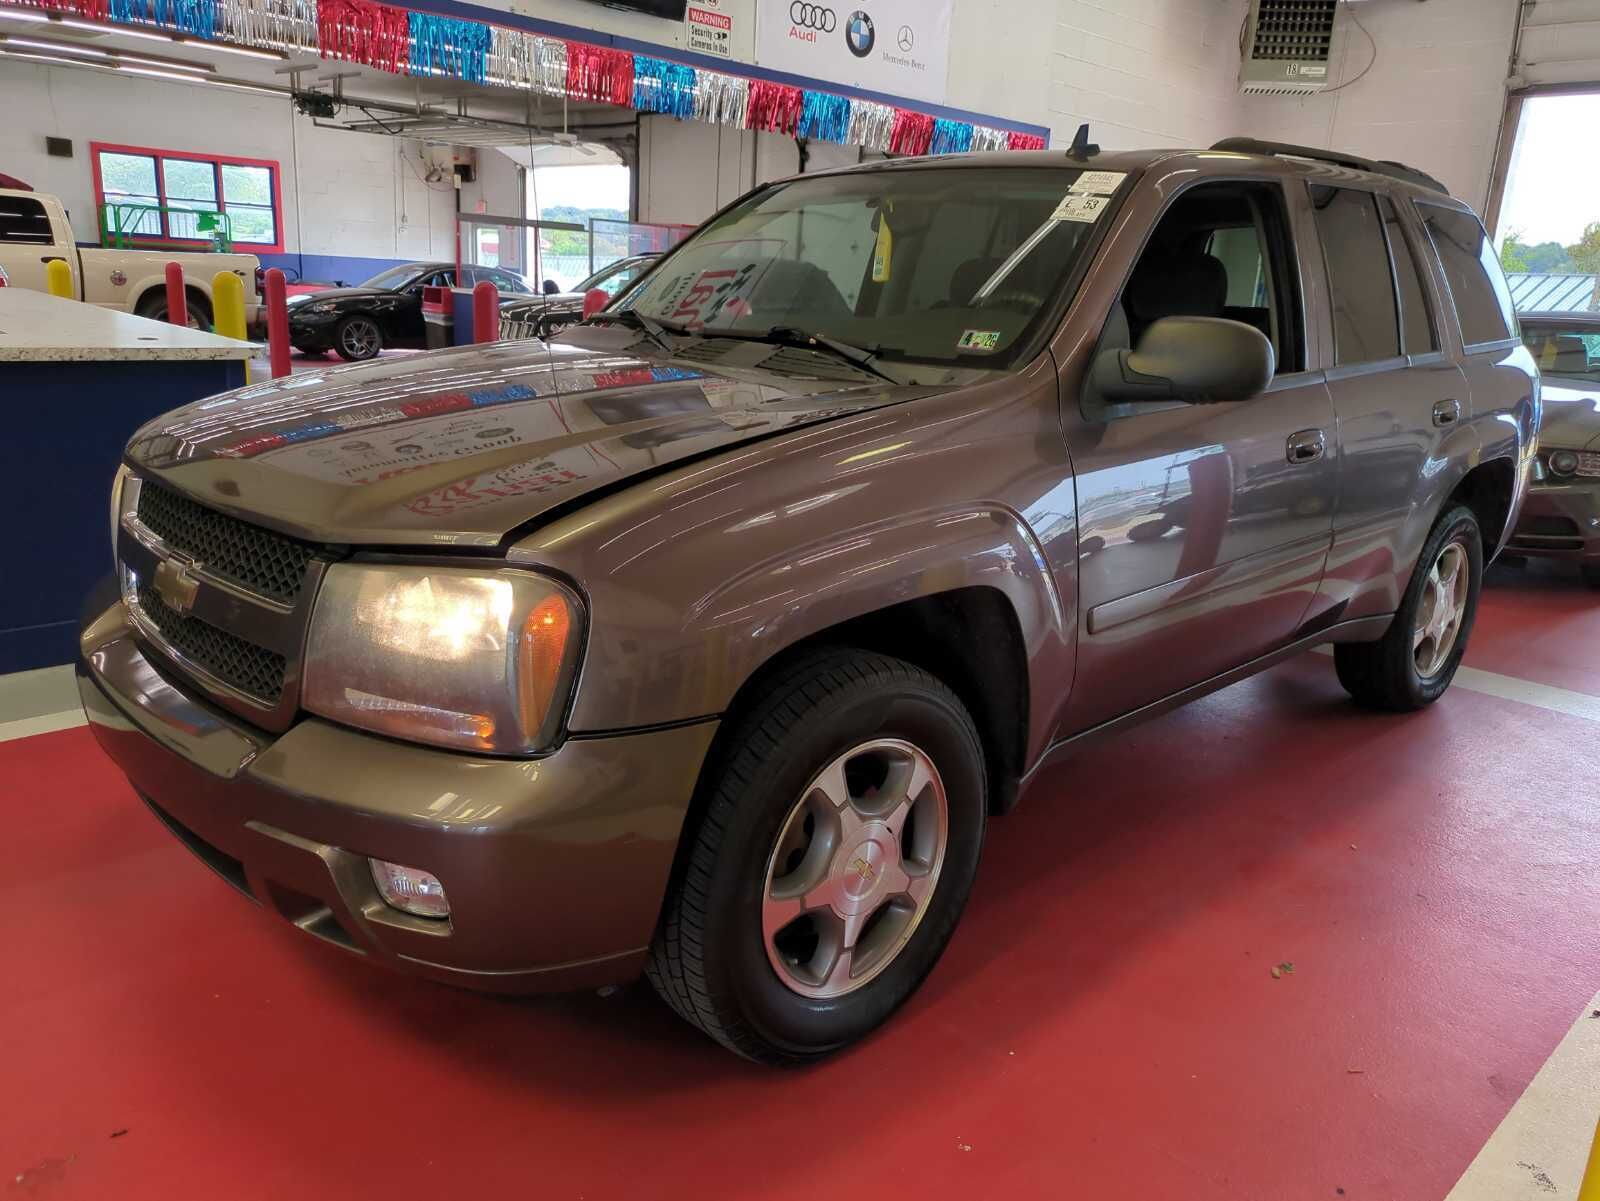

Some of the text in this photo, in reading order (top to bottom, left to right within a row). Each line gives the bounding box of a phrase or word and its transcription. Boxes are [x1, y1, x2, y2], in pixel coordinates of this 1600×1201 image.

[691, 10, 730, 29] WARNING
[691, 25, 712, 40] Security
[789, 26, 817, 43] Audi
[691, 37, 712, 50] Cameras
[1083, 200, 1100, 210] 53
